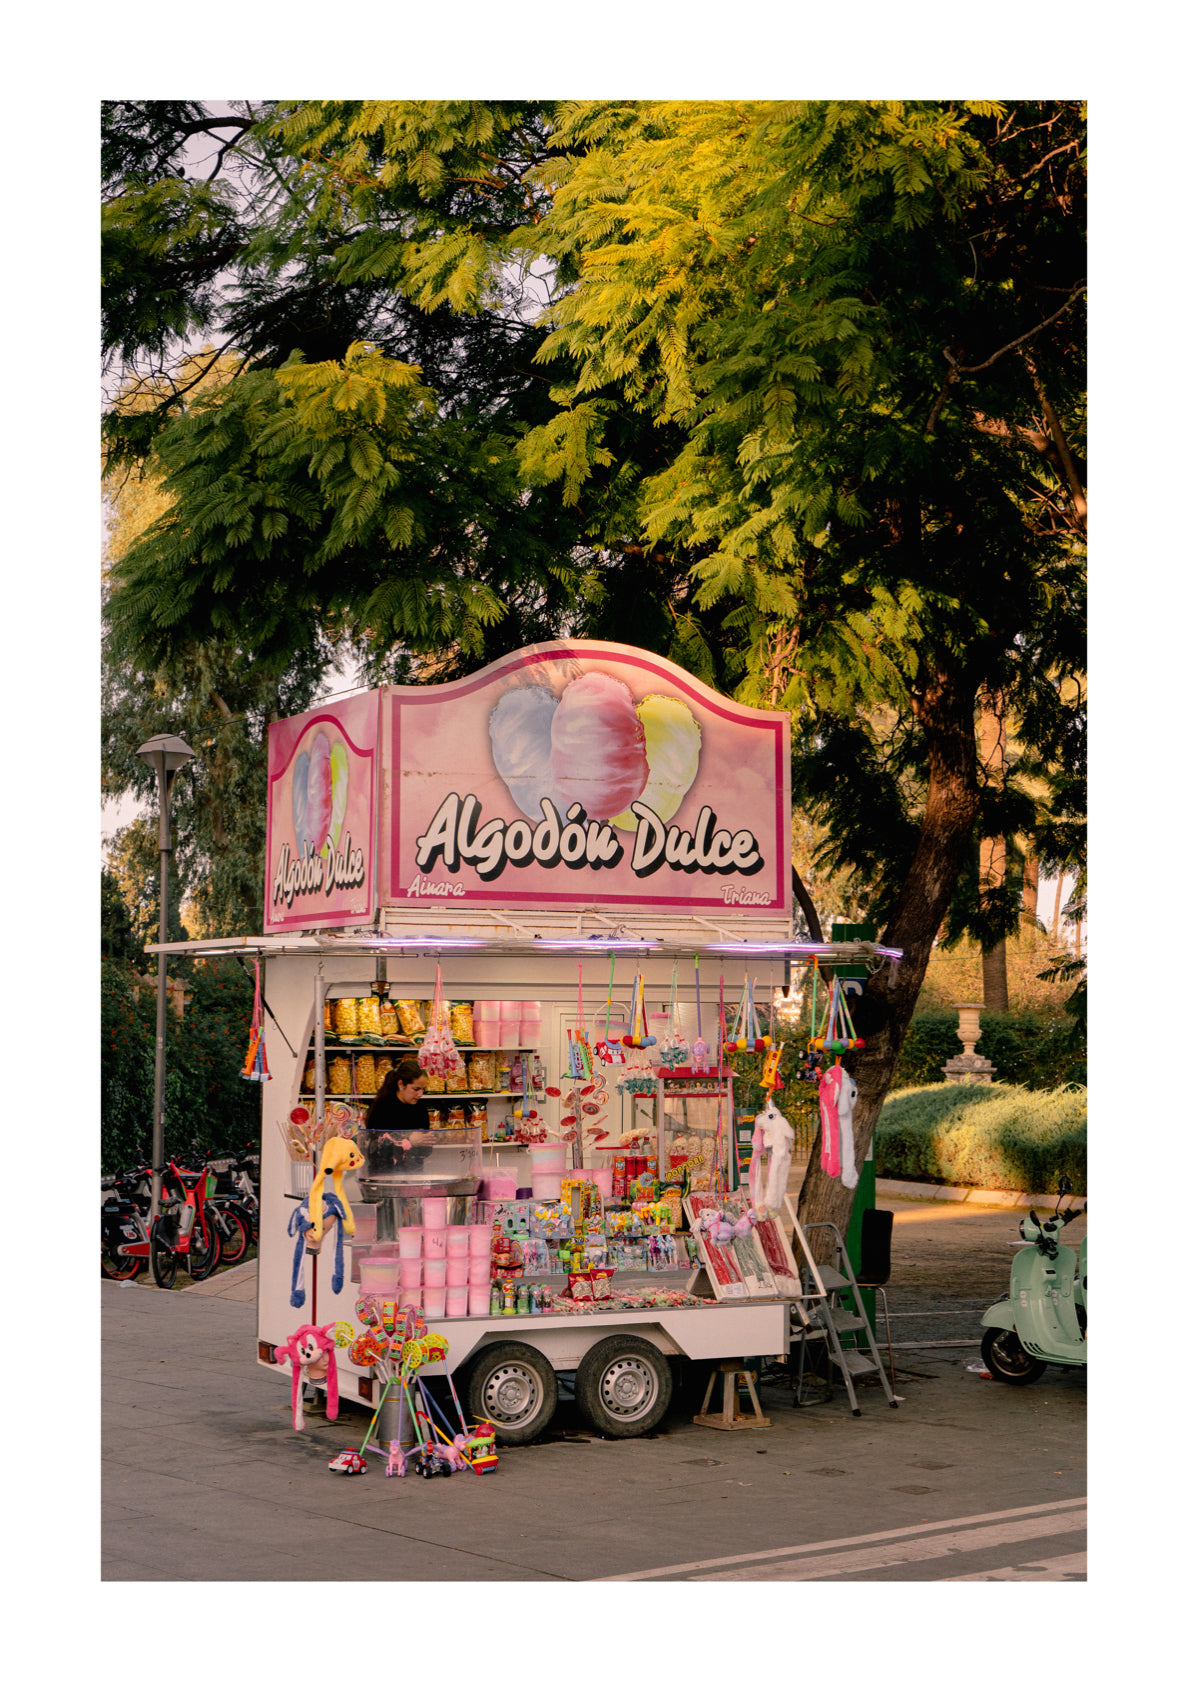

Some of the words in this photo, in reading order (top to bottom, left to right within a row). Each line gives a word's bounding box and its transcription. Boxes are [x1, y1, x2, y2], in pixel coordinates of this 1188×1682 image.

[416, 792, 624, 881] Algodón
[631, 801, 765, 879] Dulce
[272, 838, 324, 909] Algodón
[324, 830, 366, 898] Dulce
[406, 874, 466, 898] Ainara
[721, 885, 772, 906] Triana
